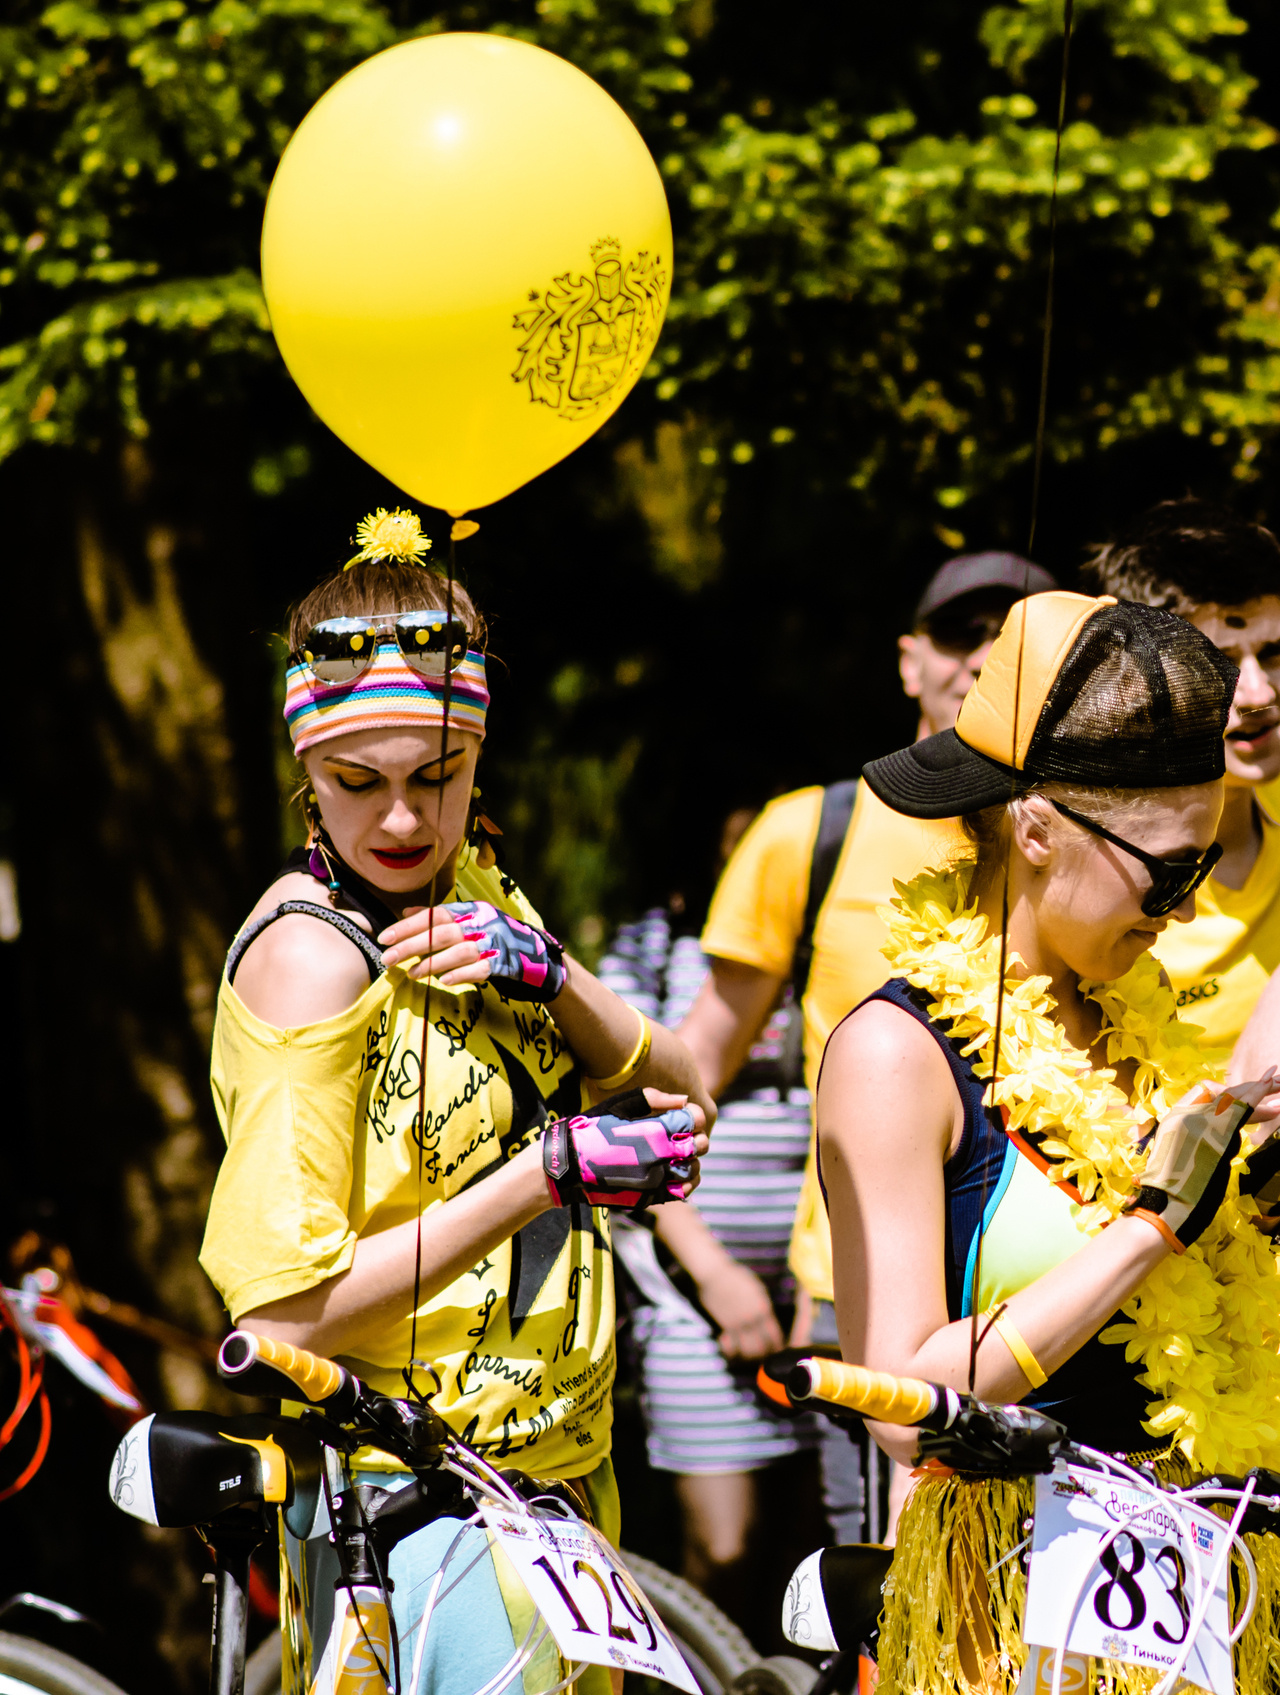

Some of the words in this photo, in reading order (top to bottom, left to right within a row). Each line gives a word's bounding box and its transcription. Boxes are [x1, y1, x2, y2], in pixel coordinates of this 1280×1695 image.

[1176, 978, 1219, 1007] asics
[411, 1056, 500, 1151] Claudia
[551, 1124, 560, 1168] cyclotech
[560, 1366, 588, 1393] friend
[219, 1475, 242, 1492] STELS
[531, 1554, 659, 1652] 129
[1093, 1529, 1191, 1645] 83
[1131, 1643, 1187, 1674] Тинько
